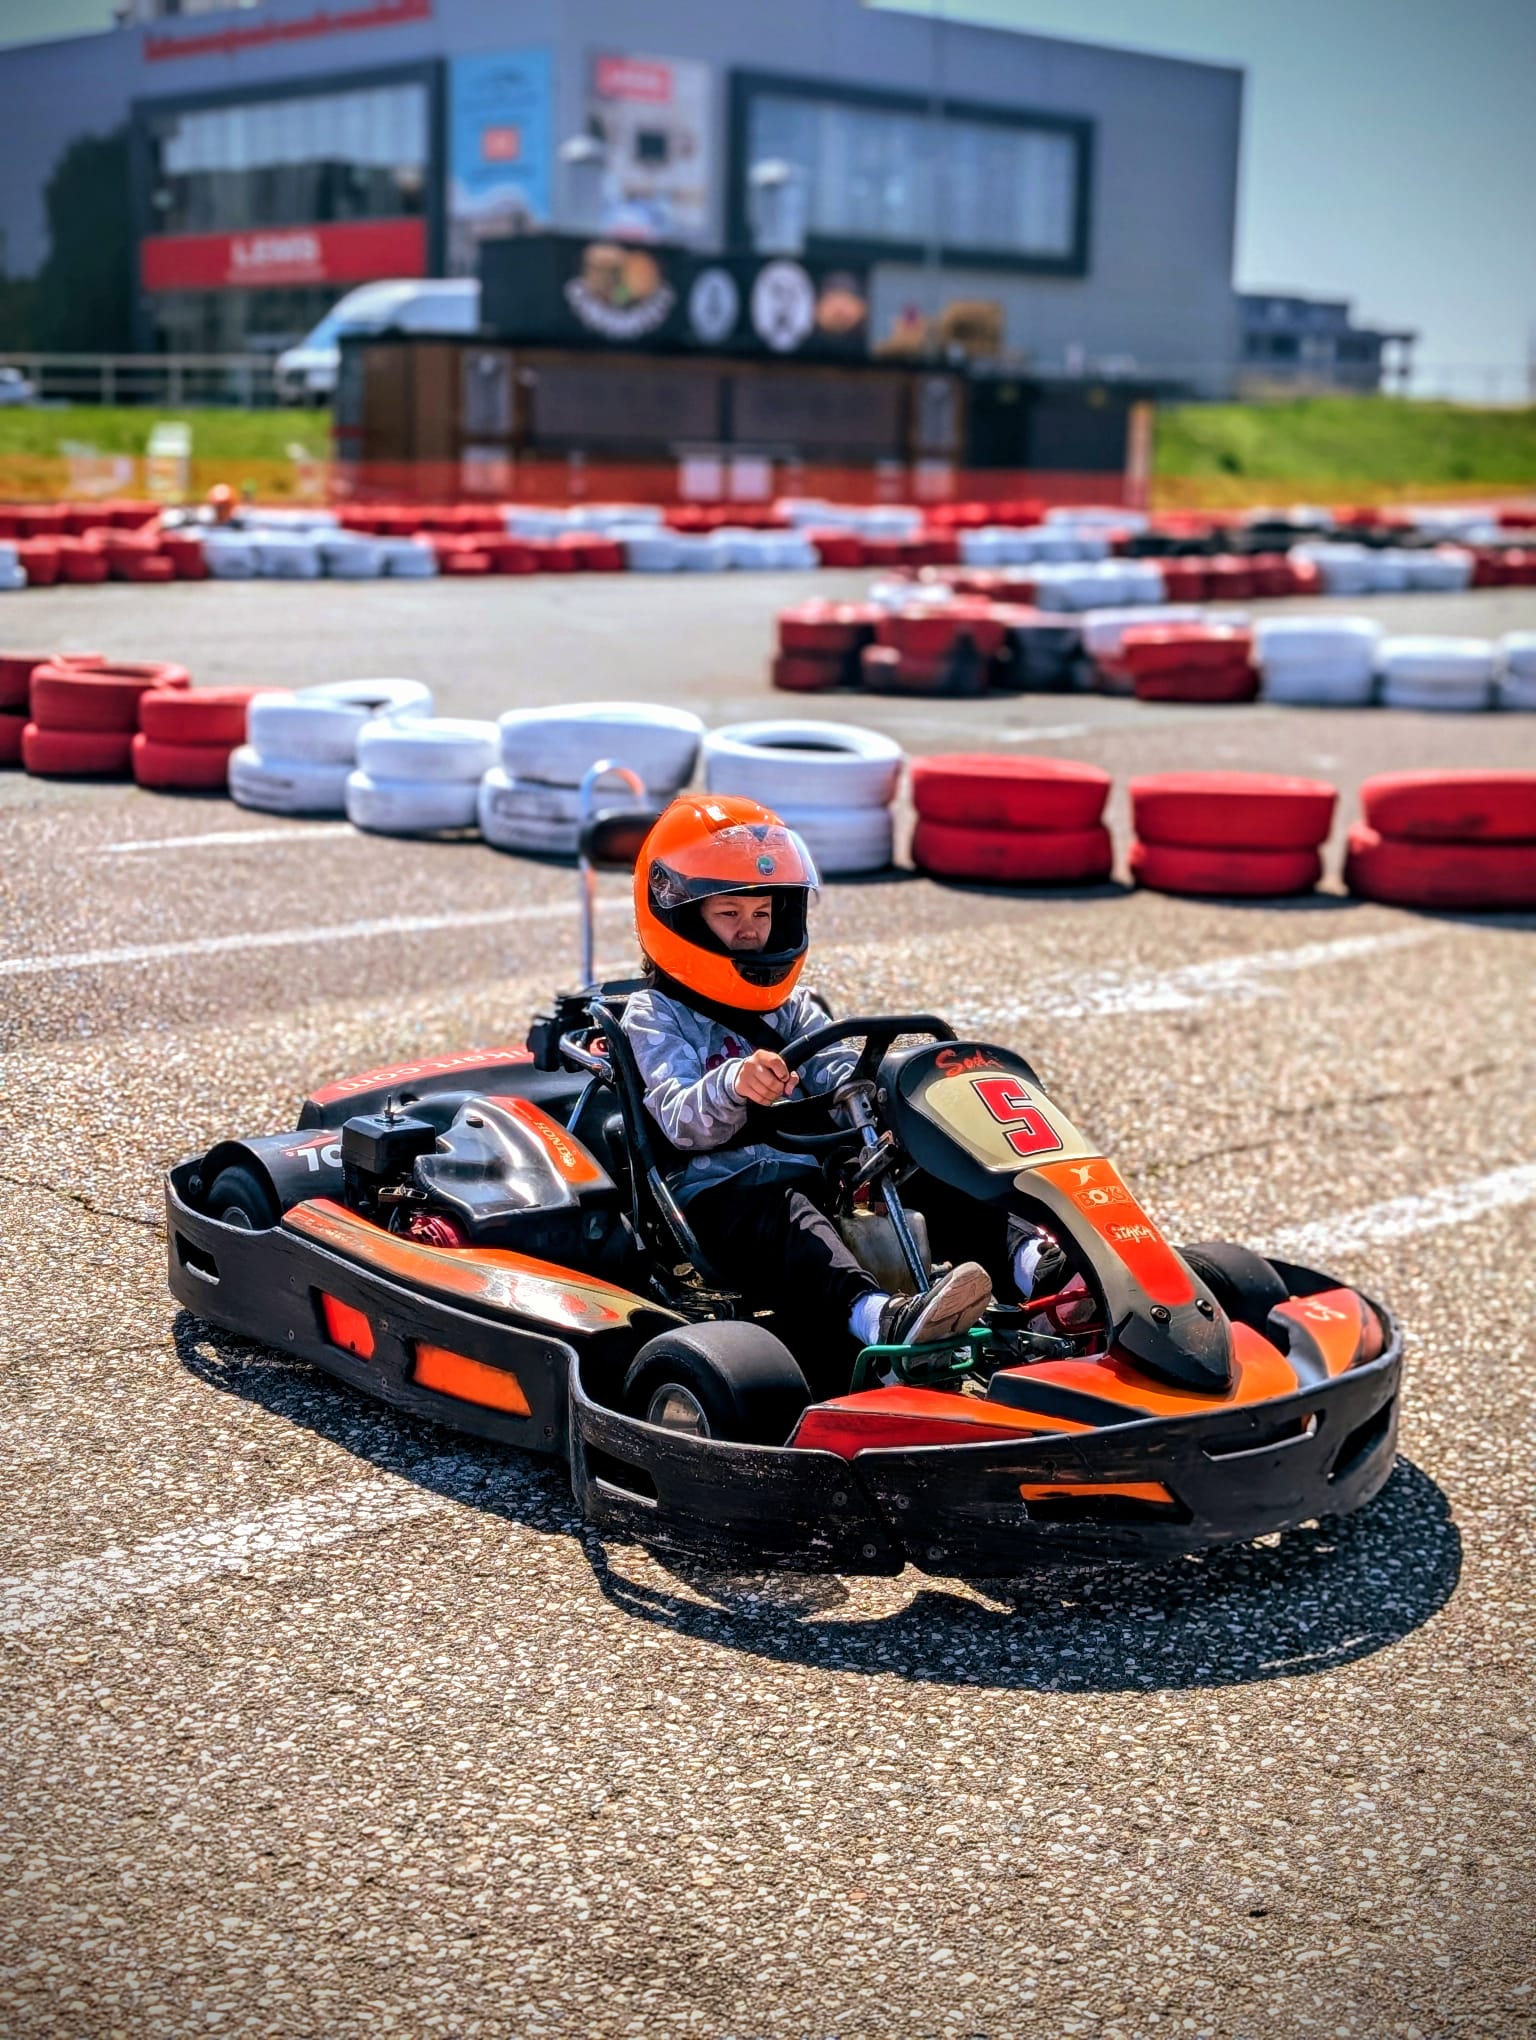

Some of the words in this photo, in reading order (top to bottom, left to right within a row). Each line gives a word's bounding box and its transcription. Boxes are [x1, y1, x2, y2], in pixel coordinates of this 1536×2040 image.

[336, 1049, 536, 1092] ikart.com
[970, 1077, 1064, 1158] 5
[297, 1144, 343, 1172] OL
